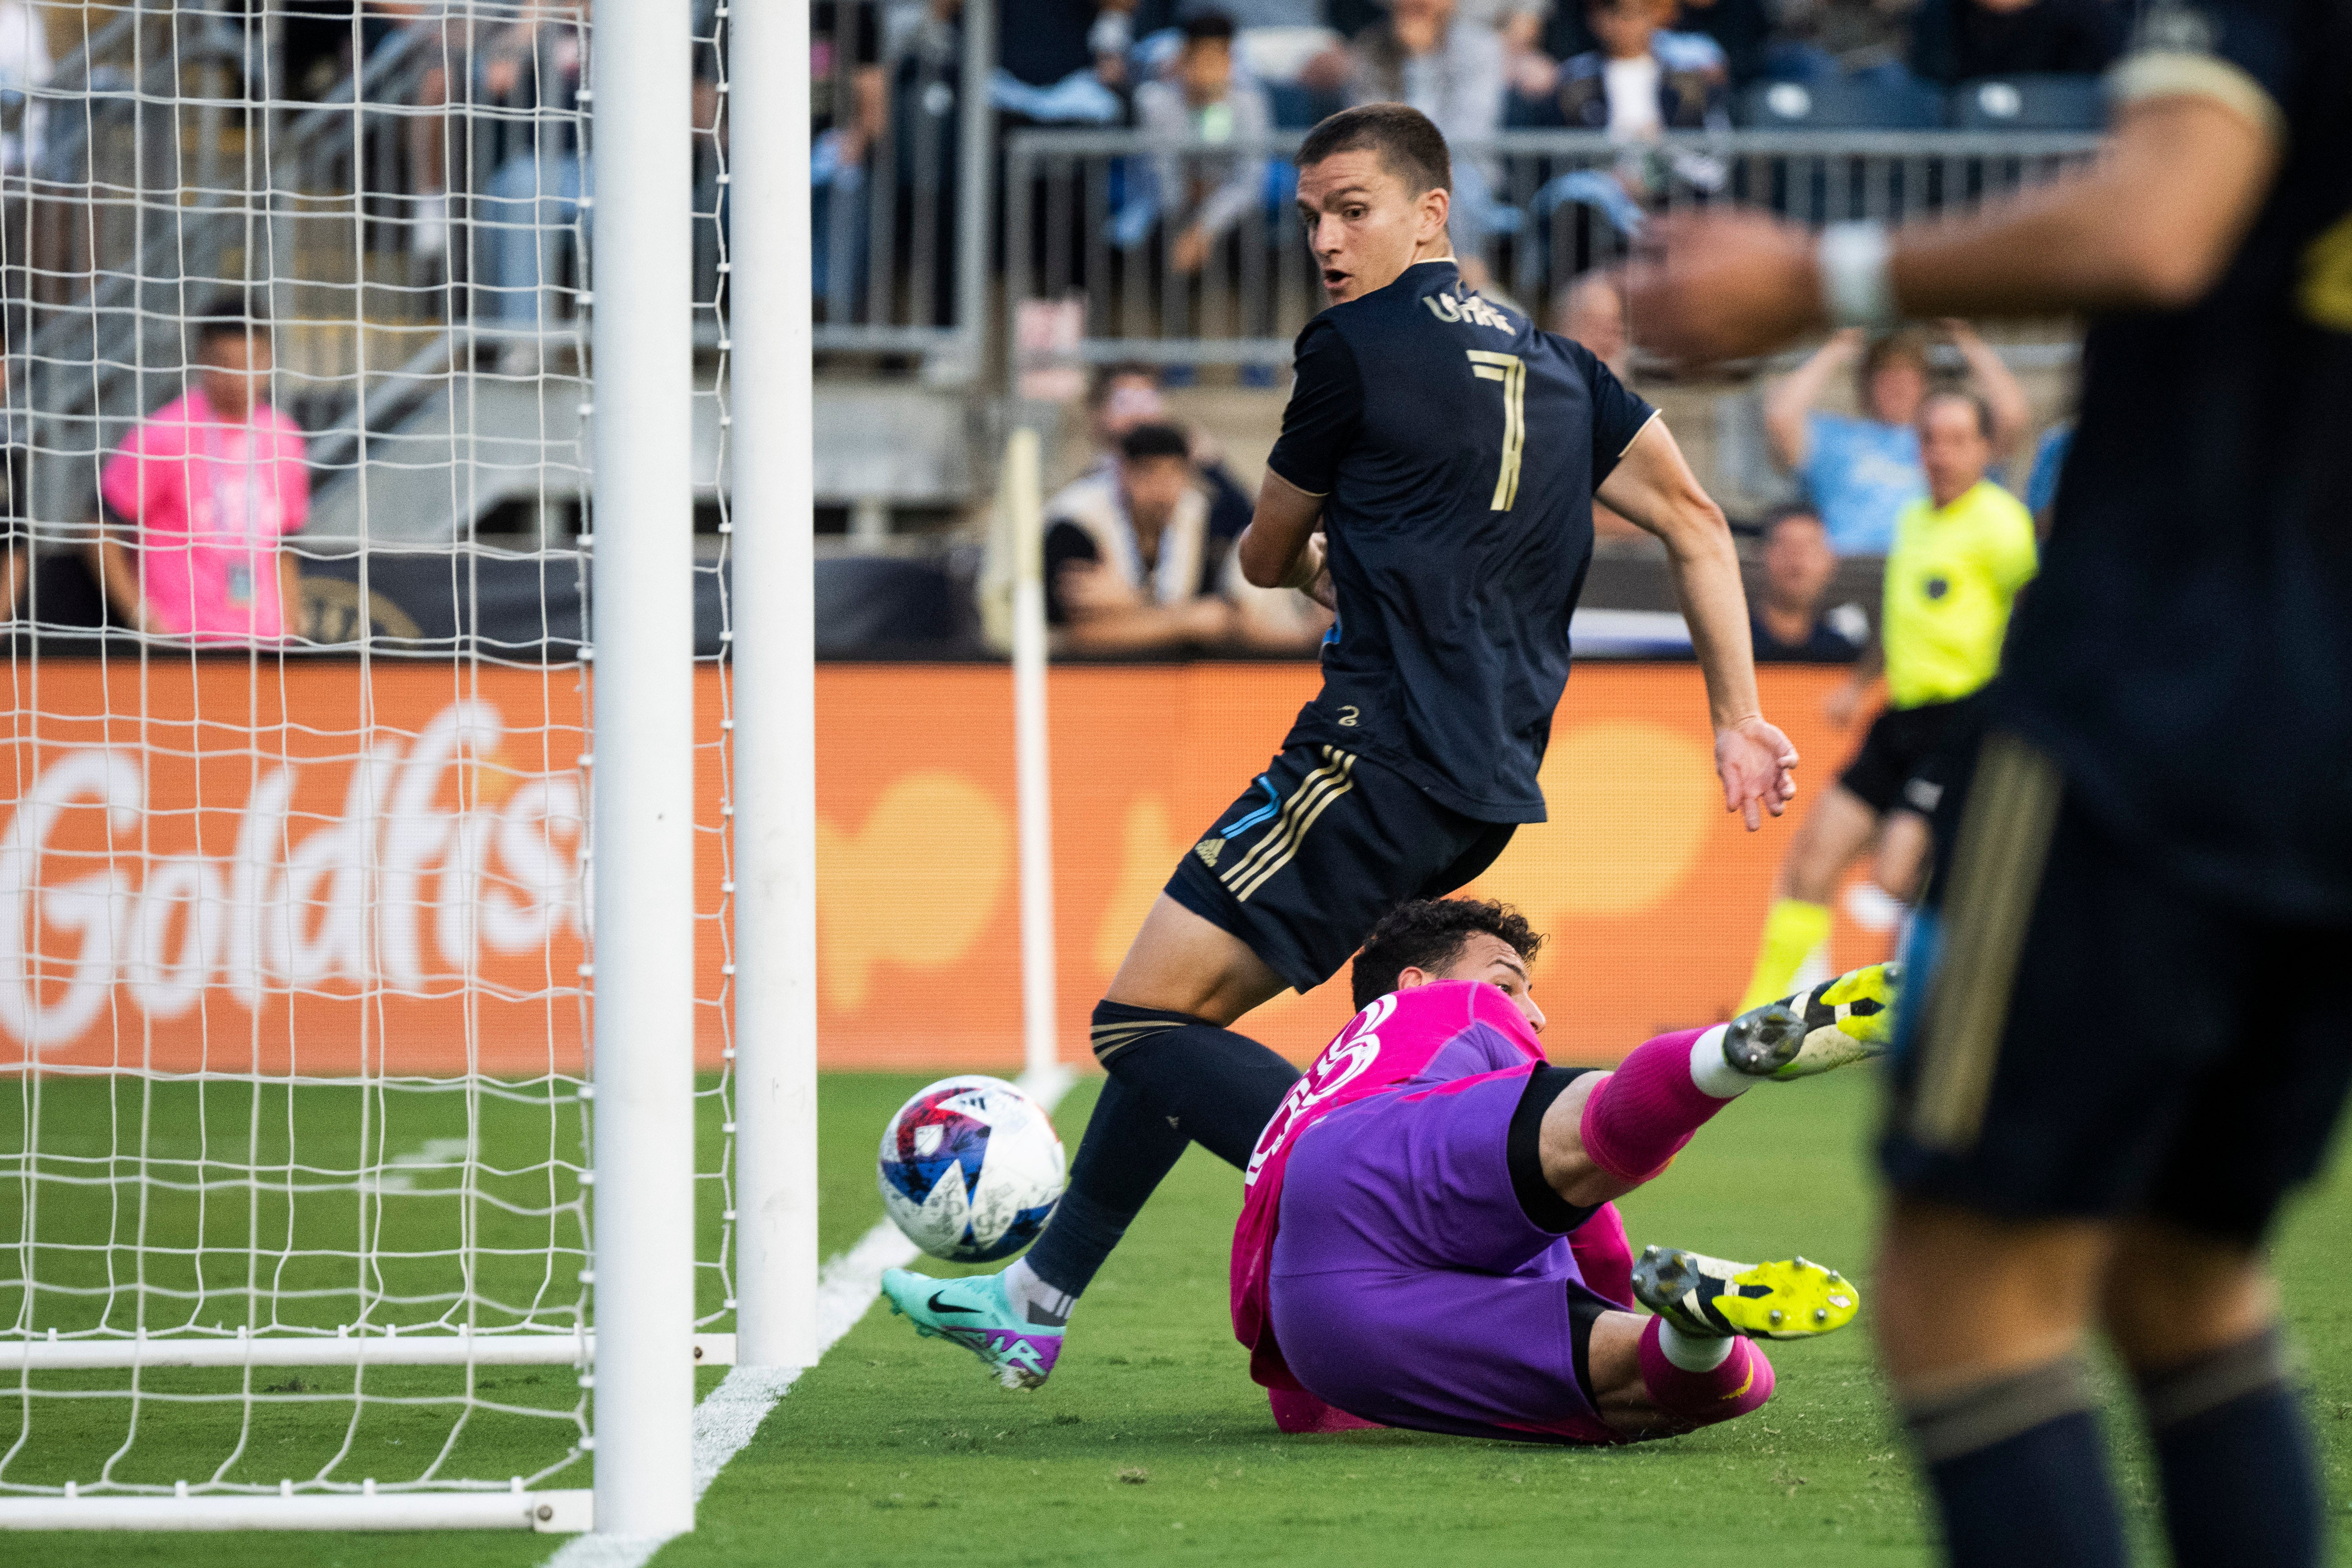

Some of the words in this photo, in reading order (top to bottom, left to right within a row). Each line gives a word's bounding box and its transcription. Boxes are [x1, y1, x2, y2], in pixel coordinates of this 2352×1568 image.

[1465, 348, 1526, 513] 7
[0, 697, 593, 1050] Goldfis
[1220, 775, 1282, 840] 7
